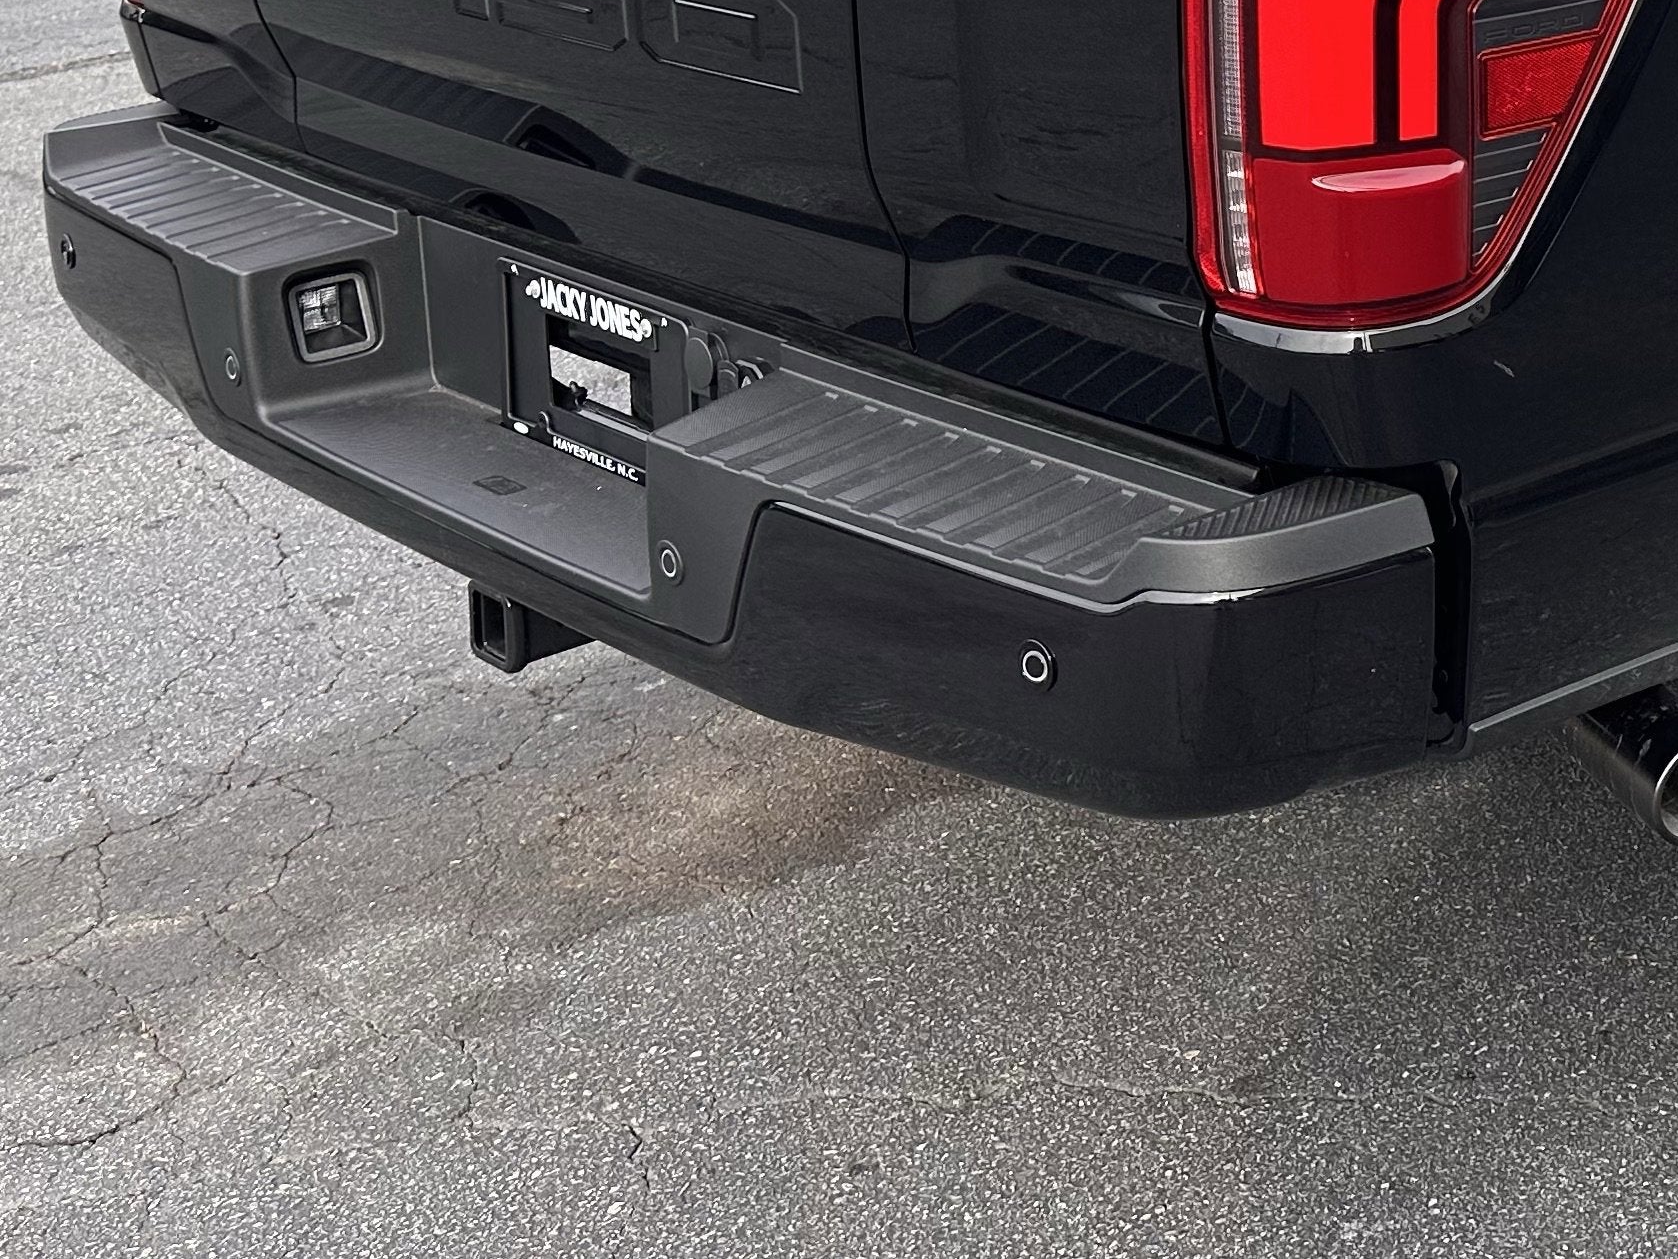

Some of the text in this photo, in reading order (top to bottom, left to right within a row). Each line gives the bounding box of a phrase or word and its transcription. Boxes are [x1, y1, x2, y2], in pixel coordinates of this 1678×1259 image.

[540, 276, 643, 342] JACKY JONES
[617, 461, 639, 482] N.C.
